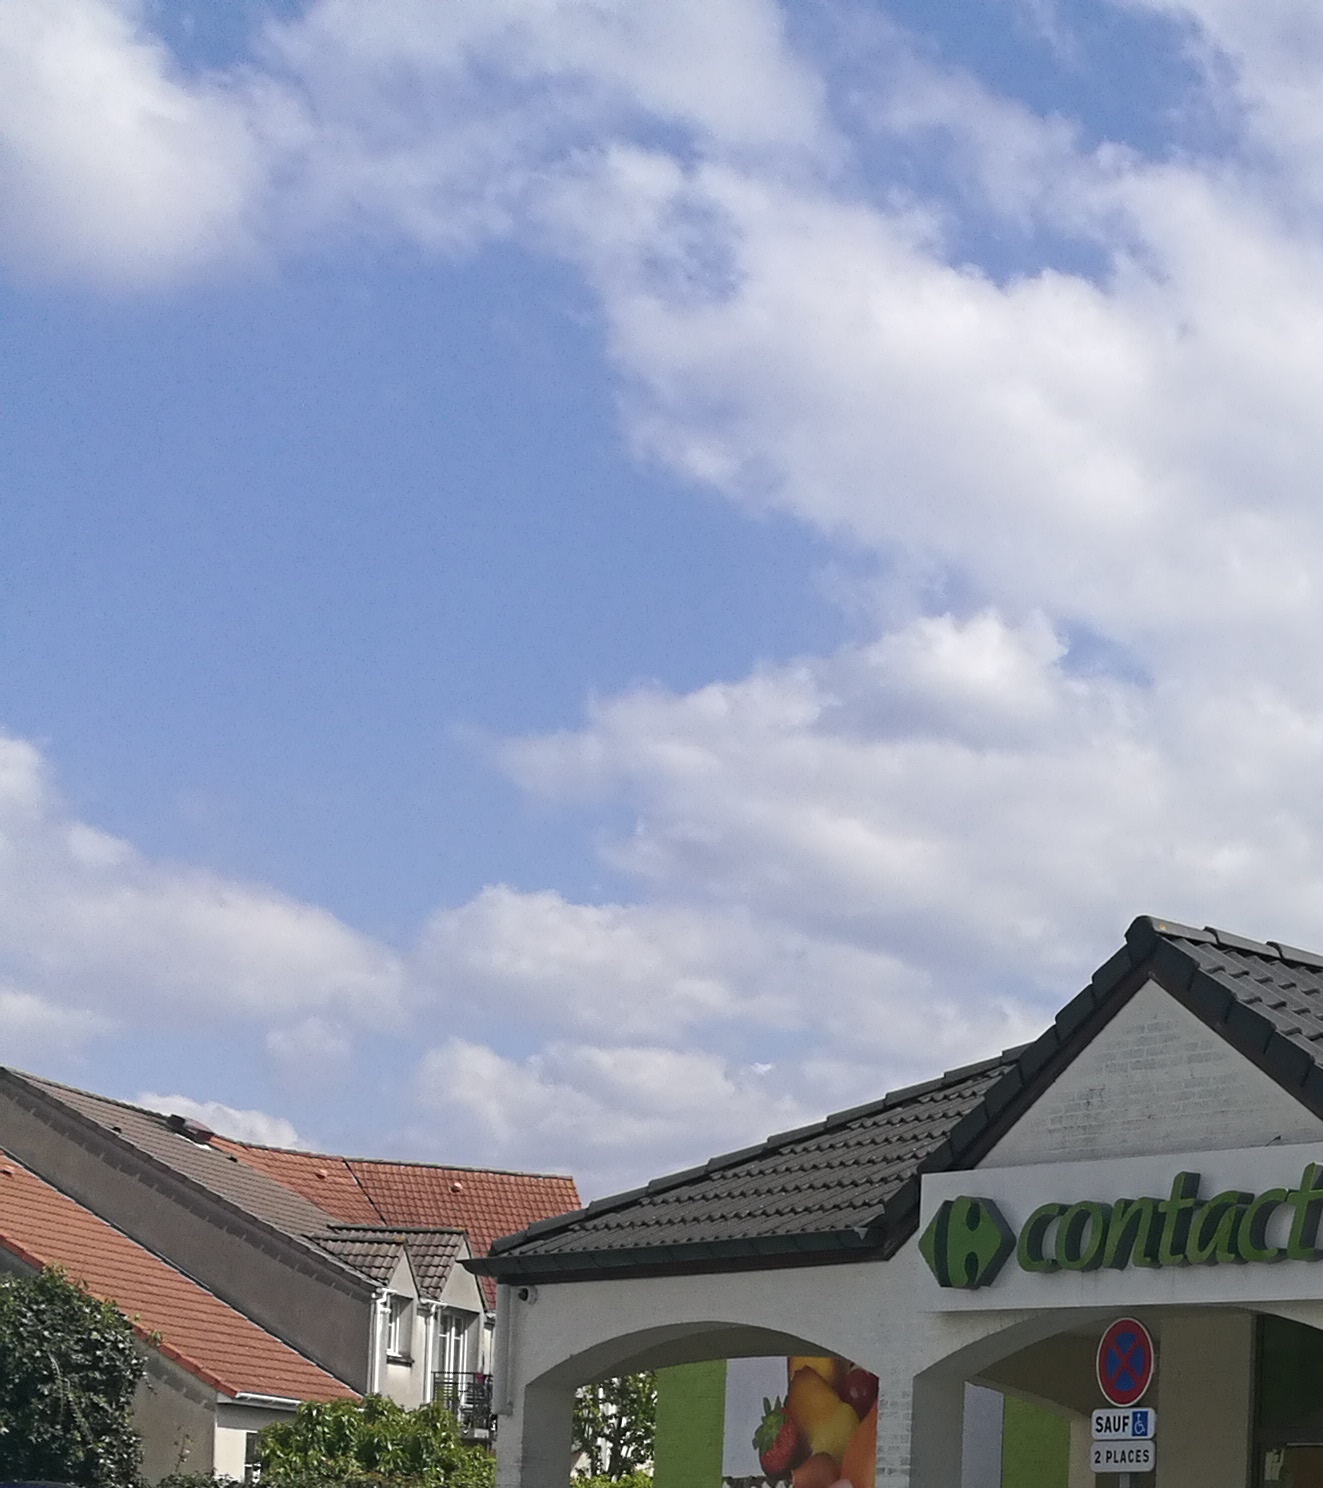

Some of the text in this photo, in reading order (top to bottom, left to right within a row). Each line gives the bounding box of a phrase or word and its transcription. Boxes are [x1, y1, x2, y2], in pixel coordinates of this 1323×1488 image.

[1095, 1416, 1130, 1433] SAUF
[1094, 1449, 1150, 1464] 2 PLACES
